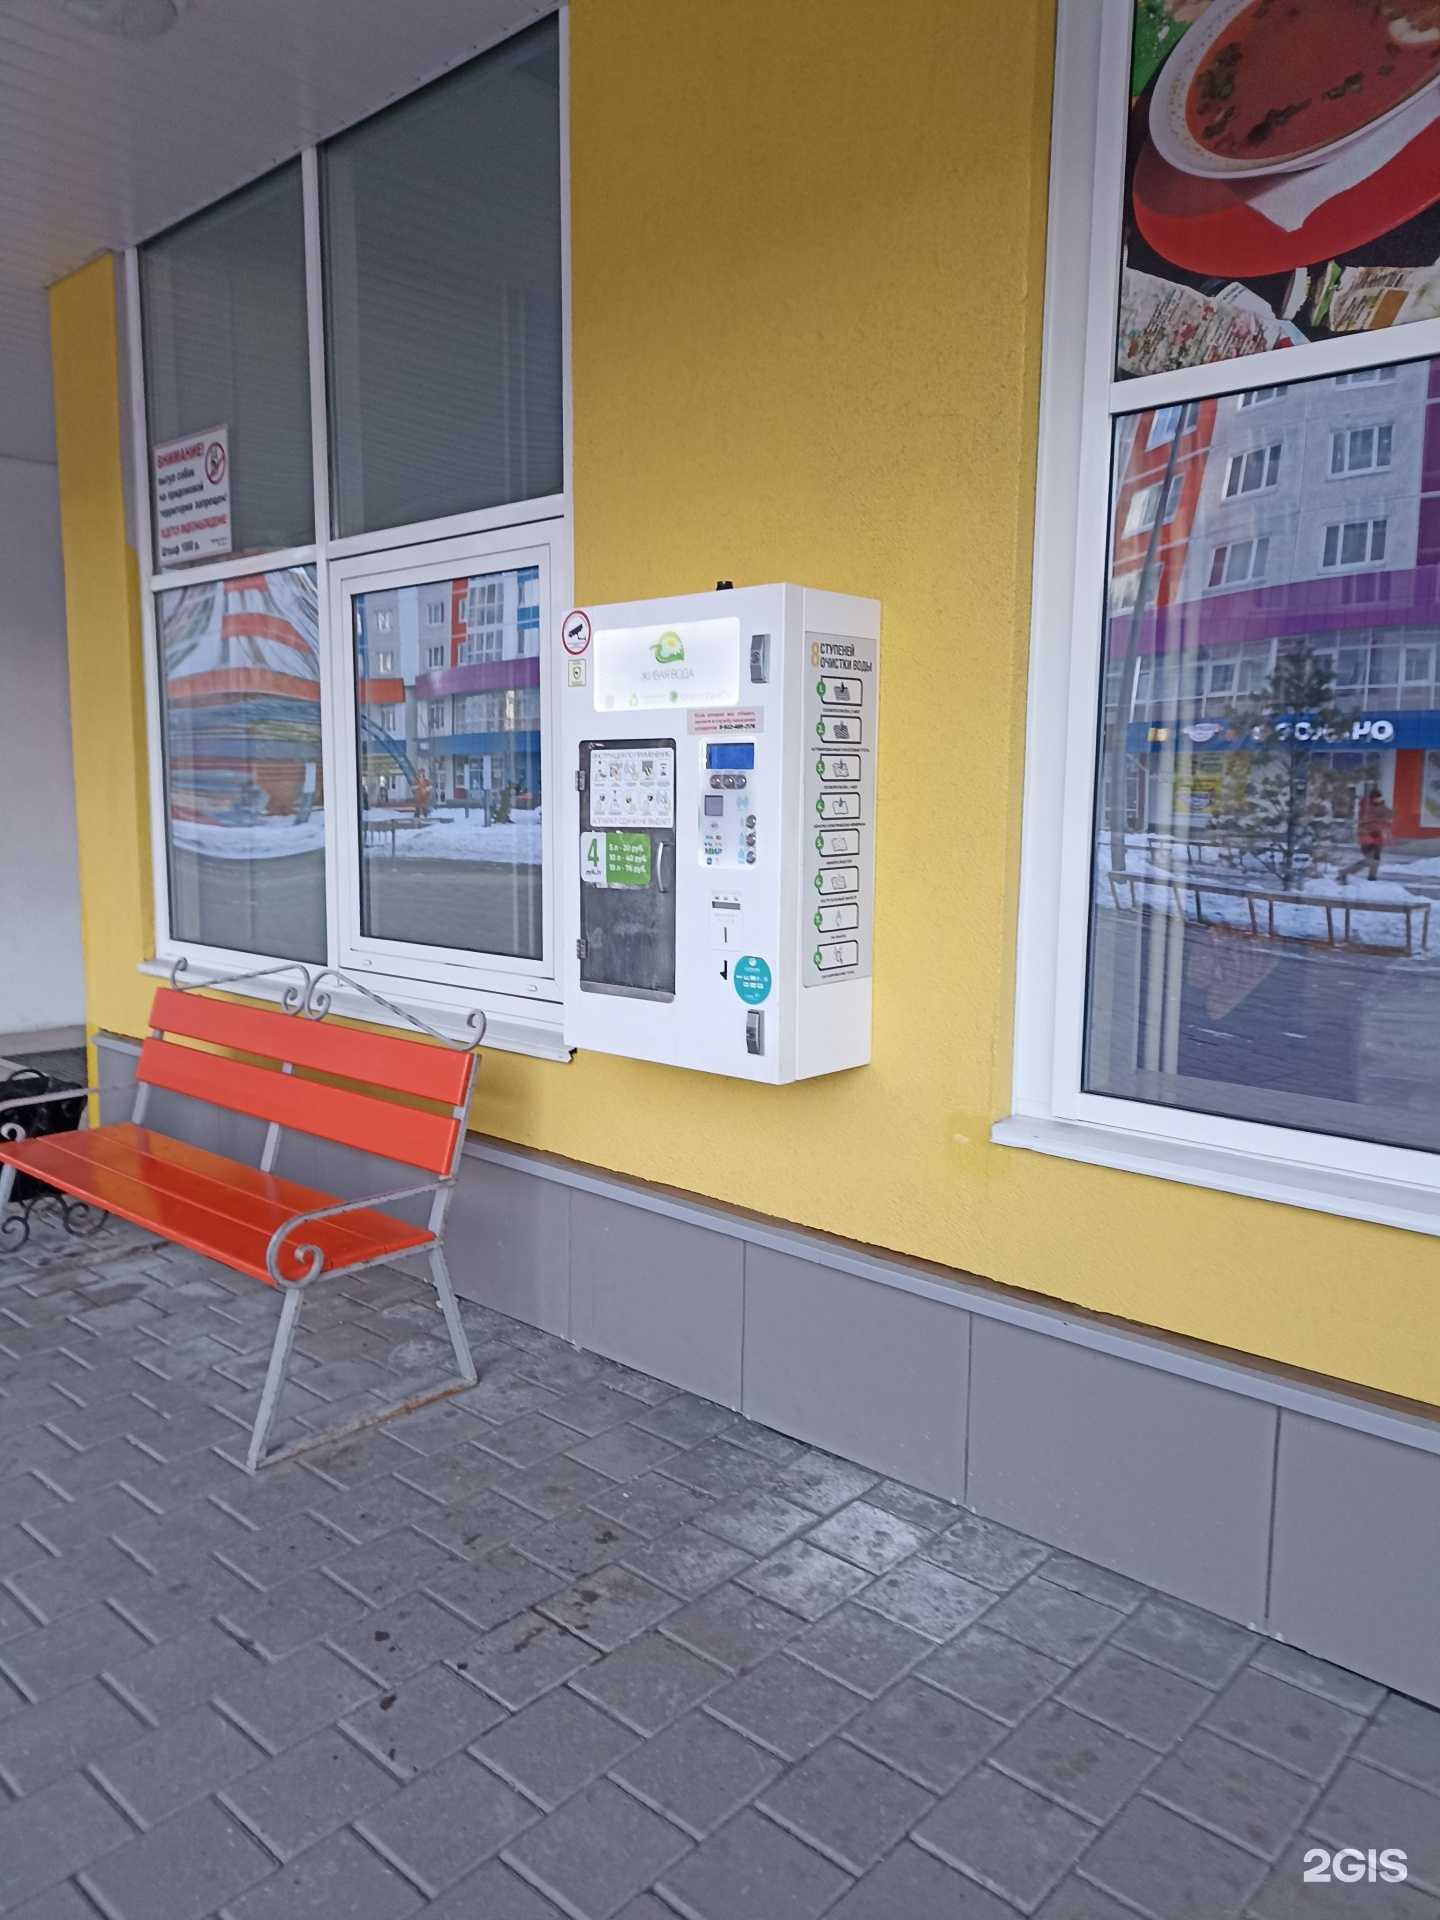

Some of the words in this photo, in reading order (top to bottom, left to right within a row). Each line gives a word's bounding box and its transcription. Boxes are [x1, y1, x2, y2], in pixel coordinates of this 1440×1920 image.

[811, 640, 819, 667] 8
[820, 643, 855, 656] СТУПЕНЕЙ
[820, 657, 851, 670] ОЧИСТКИ
[853, 660, 872, 672] ВОДЫ
[587, 838, 599, 867] 4
